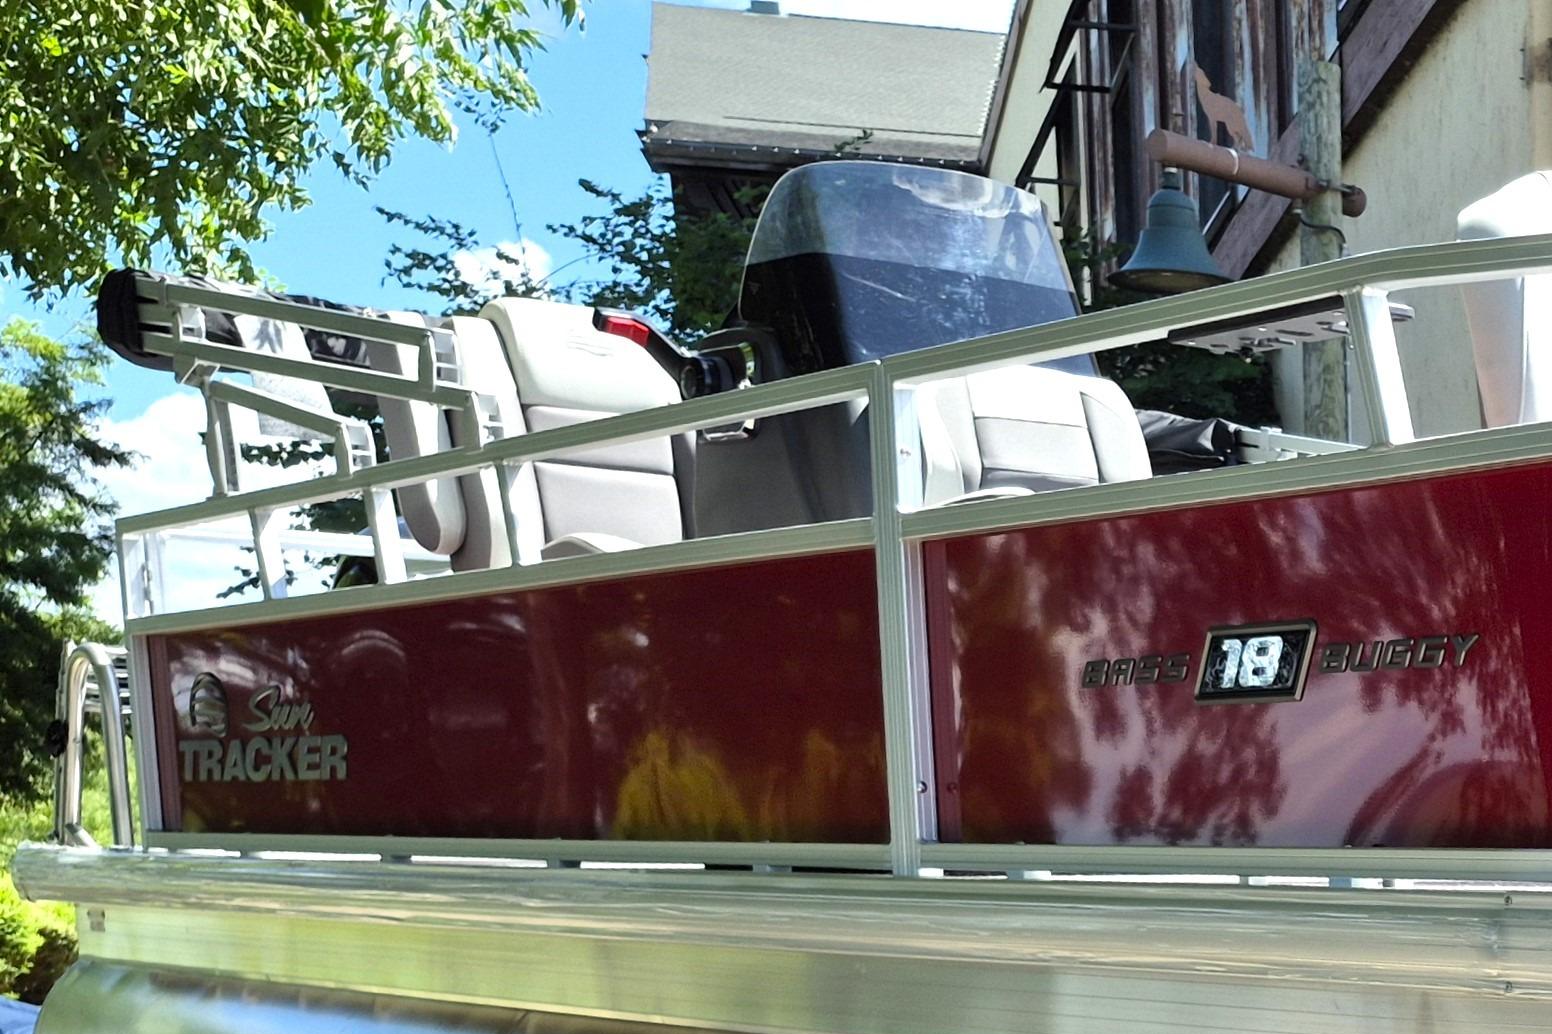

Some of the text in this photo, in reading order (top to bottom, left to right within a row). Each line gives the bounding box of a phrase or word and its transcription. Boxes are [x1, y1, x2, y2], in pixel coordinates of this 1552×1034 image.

[1082, 634, 1480, 689] BASS 18 BUGGY
[242, 685, 314, 732] Sun
[179, 734, 348, 783] TRACKER
